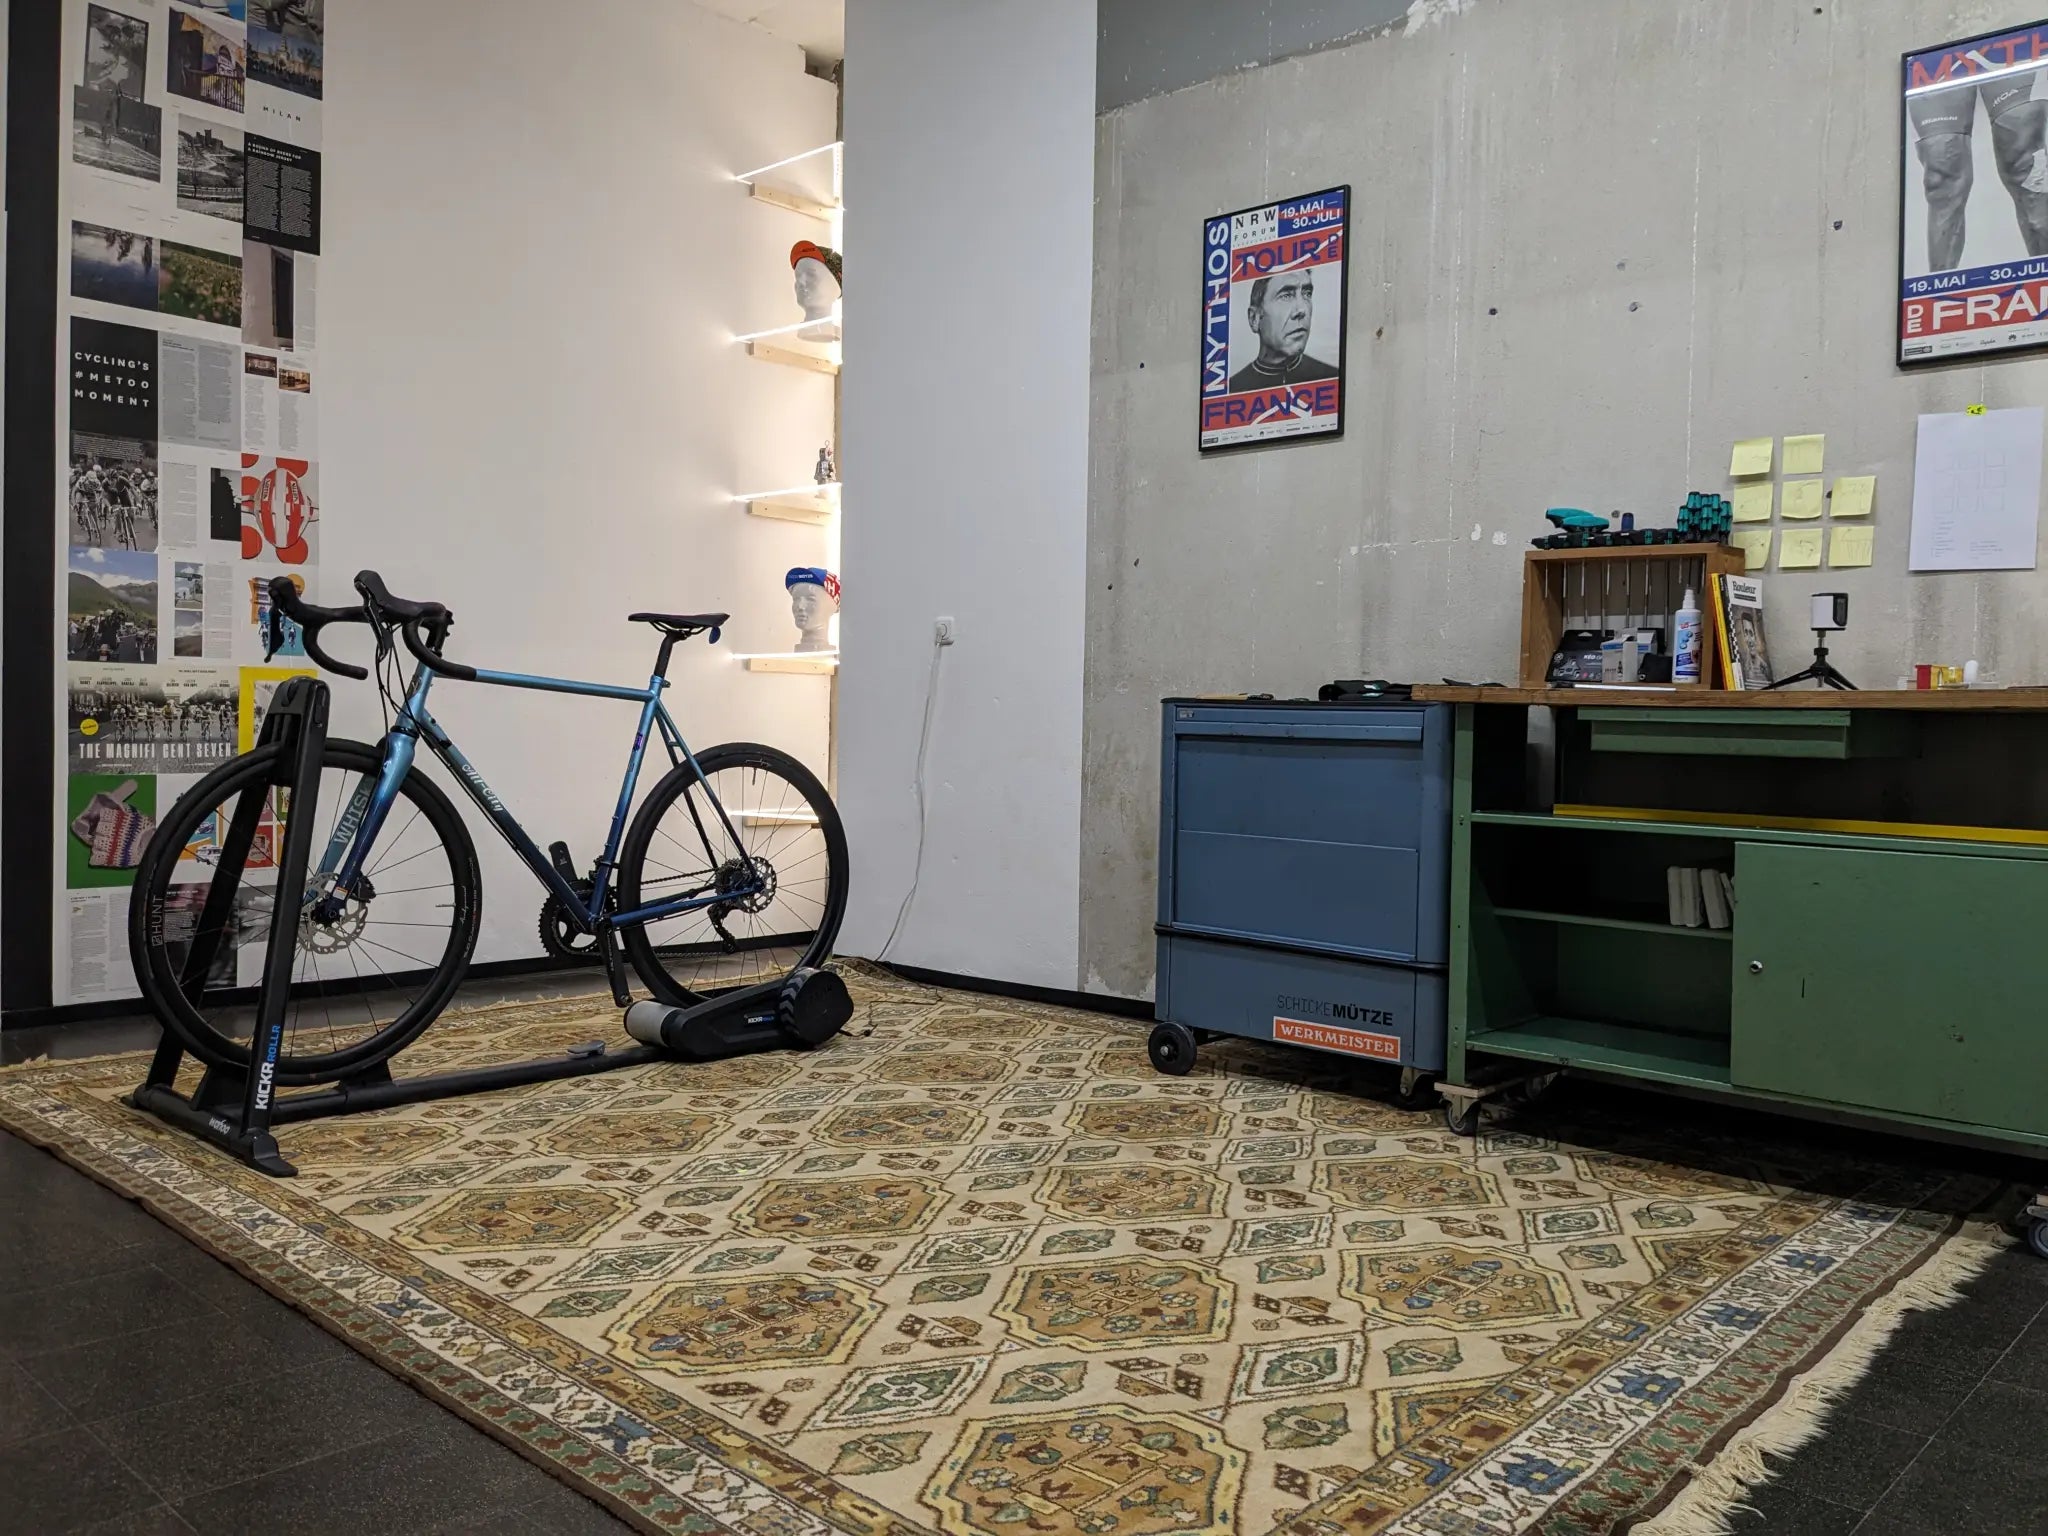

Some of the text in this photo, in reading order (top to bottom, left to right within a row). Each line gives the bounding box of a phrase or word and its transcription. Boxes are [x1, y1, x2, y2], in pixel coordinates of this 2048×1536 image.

[263, 106, 301, 122] MILAN
[1235, 209, 1276, 230] NRW
[1234, 226, 1276, 241] FORUM
[1236, 238, 1321, 276] TOUR
[1206, 221, 1229, 393] MYTHOS
[74, 351, 150, 371] CYCLING'S
[74, 389, 150, 407] MOMENT
[1204, 385, 1336, 427] FRANCE
[79, 743, 101, 759] THE
[196, 742, 231, 758] SEVEN
[152, 895, 164, 934] HUNT
[1280, 1024, 1395, 1054] WERKMEISTER
[255, 1025, 280, 1110] KICKR ROLLR
